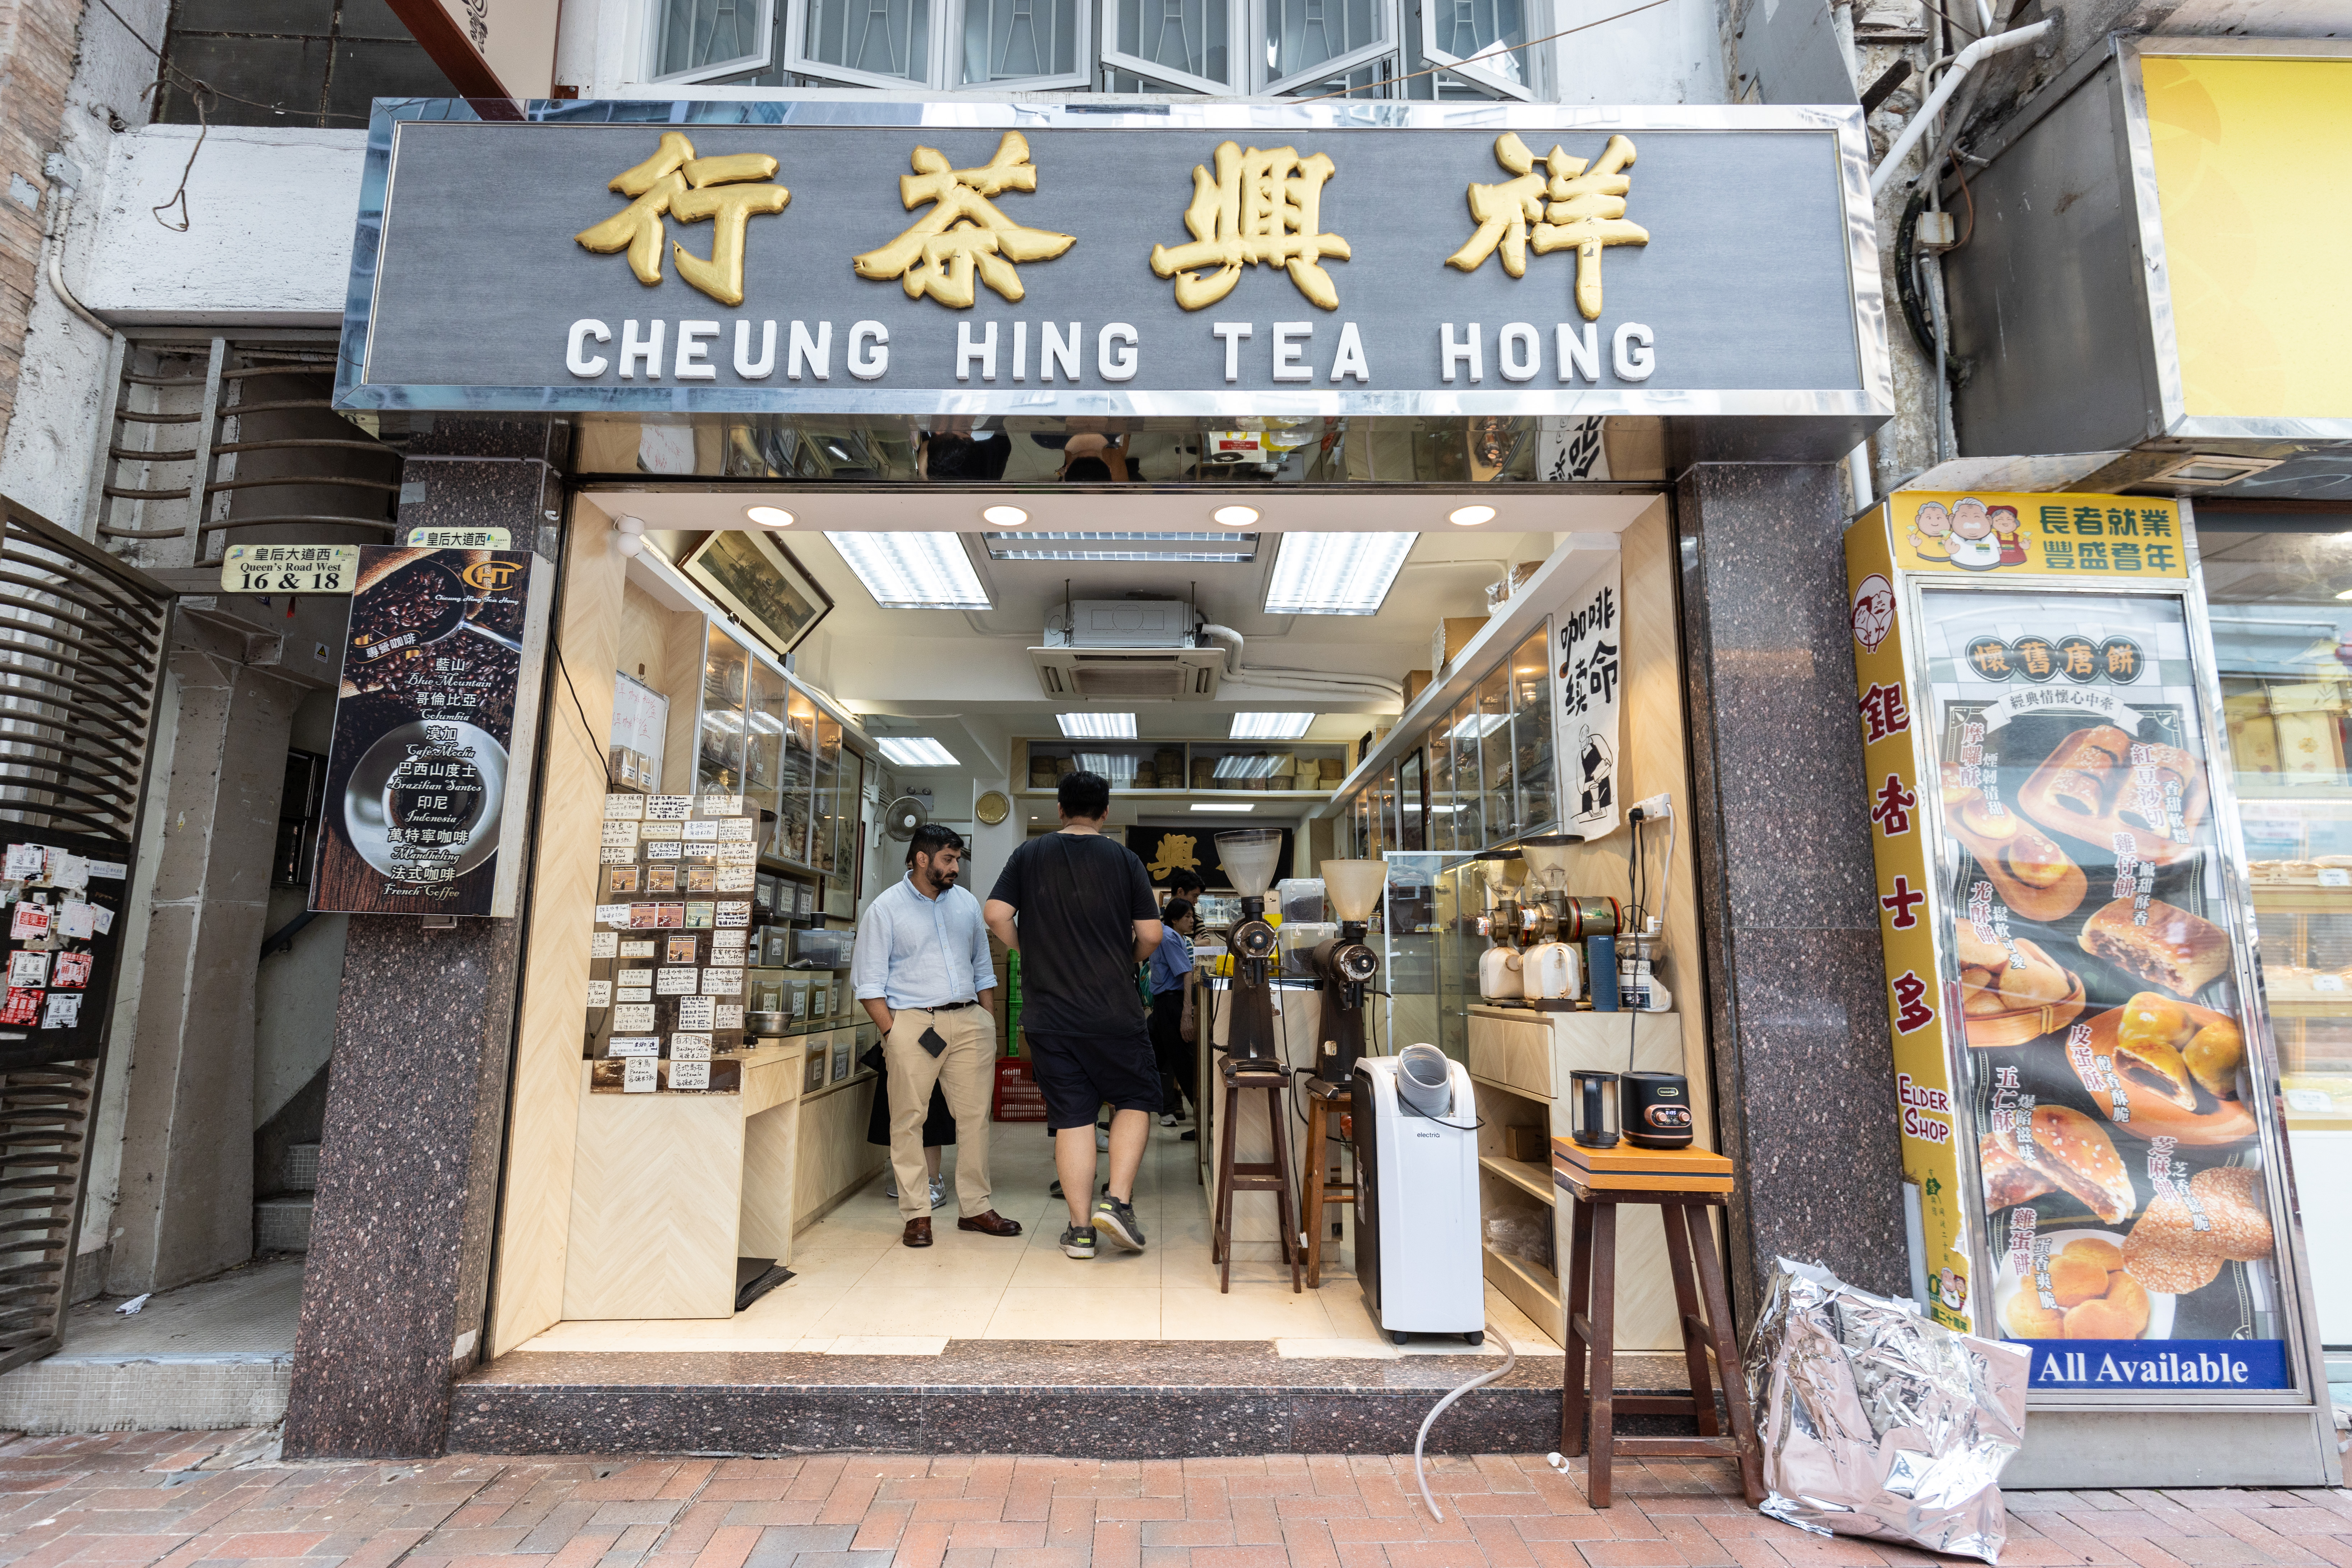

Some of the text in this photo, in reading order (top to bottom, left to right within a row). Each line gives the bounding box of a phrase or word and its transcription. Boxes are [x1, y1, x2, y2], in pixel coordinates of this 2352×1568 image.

[566, 319, 1656, 382] CHEUNG HING TEA HONG
[2040, 506, 2172, 538] 長者就業
[254, 548, 331, 561] 皇后大道西
[427, 532, 487, 546] 皇后大道西
[240, 563, 341, 573] Queen's Road West
[2043, 541, 2177, 572] 豐盛耆年
[242, 573, 340, 590] 16 & 18
[463, 595, 482, 603] Hing
[498, 597, 520, 605] Hong
[1561, 586, 1615, 674] 咖啡
[365, 633, 416, 659] 專營咖啡
[1974, 642, 2135, 674] 懷舊唐餅
[435, 658, 465, 671] 藍山
[1566, 640, 1618, 716] 续命
[405, 673, 492, 688] Blue Mountain
[415, 692, 477, 707] 哥倫比亞
[421, 709, 470, 721] Columbia
[2009, 688, 2114, 711] 經典情懷心中牽
[406, 744, 475, 759] Café Mocha
[1960, 722, 1985, 788] 摩囉酥
[387, 776, 482, 792] Brazilian Santos
[399, 762, 477, 777] 巴西山度士
[1982, 753, 2006, 815] 煙韌清甜
[418, 795, 448, 809] 印尼
[2130, 745, 2167, 829] 紅豆沙切
[405, 809, 457, 823] Indonesia
[603, 822, 632, 831] 精選藍山
[2162, 780, 2190, 845] 香甜軟糯
[388, 828, 469, 843] 萬特寧咖啡
[391, 845, 460, 863] Mandheling
[1859, 681, 1934, 1036] 銀杏士多
[2113, 832, 2138, 898] 雞仔餅
[391, 866, 456, 881] 法式咖啡
[384, 883, 460, 901] French Coffee
[2132, 861, 2156, 927] 鹹甜酥香
[1969, 881, 1998, 944] 光酥餅
[1992, 906, 2027, 970] 鬆軟可愛
[629, 1059, 651, 1068] 巴拿馬
[676, 1063, 705, 1072] 危地馬拉
[2069, 1024, 2107, 1092] 皮蛋酥
[1898, 1073, 1951, 1114] ELDER
[1991, 1066, 2020, 1133] 五仁酥
[2094, 1055, 2131, 1123] 醇香酥脆
[1904, 1111, 1951, 1144] SHOP
[2016, 1094, 2037, 1162] 爆餡滋味
[2147, 1135, 2180, 1203] 芝麻餅
[2171, 1161, 2211, 1232] 芝香鬆脆
[2009, 1208, 2037, 1275] 雞蛋餅
[2033, 1238, 2058, 1310] 蛋香爽脆
[2038, 1353, 2248, 1383] All Available
